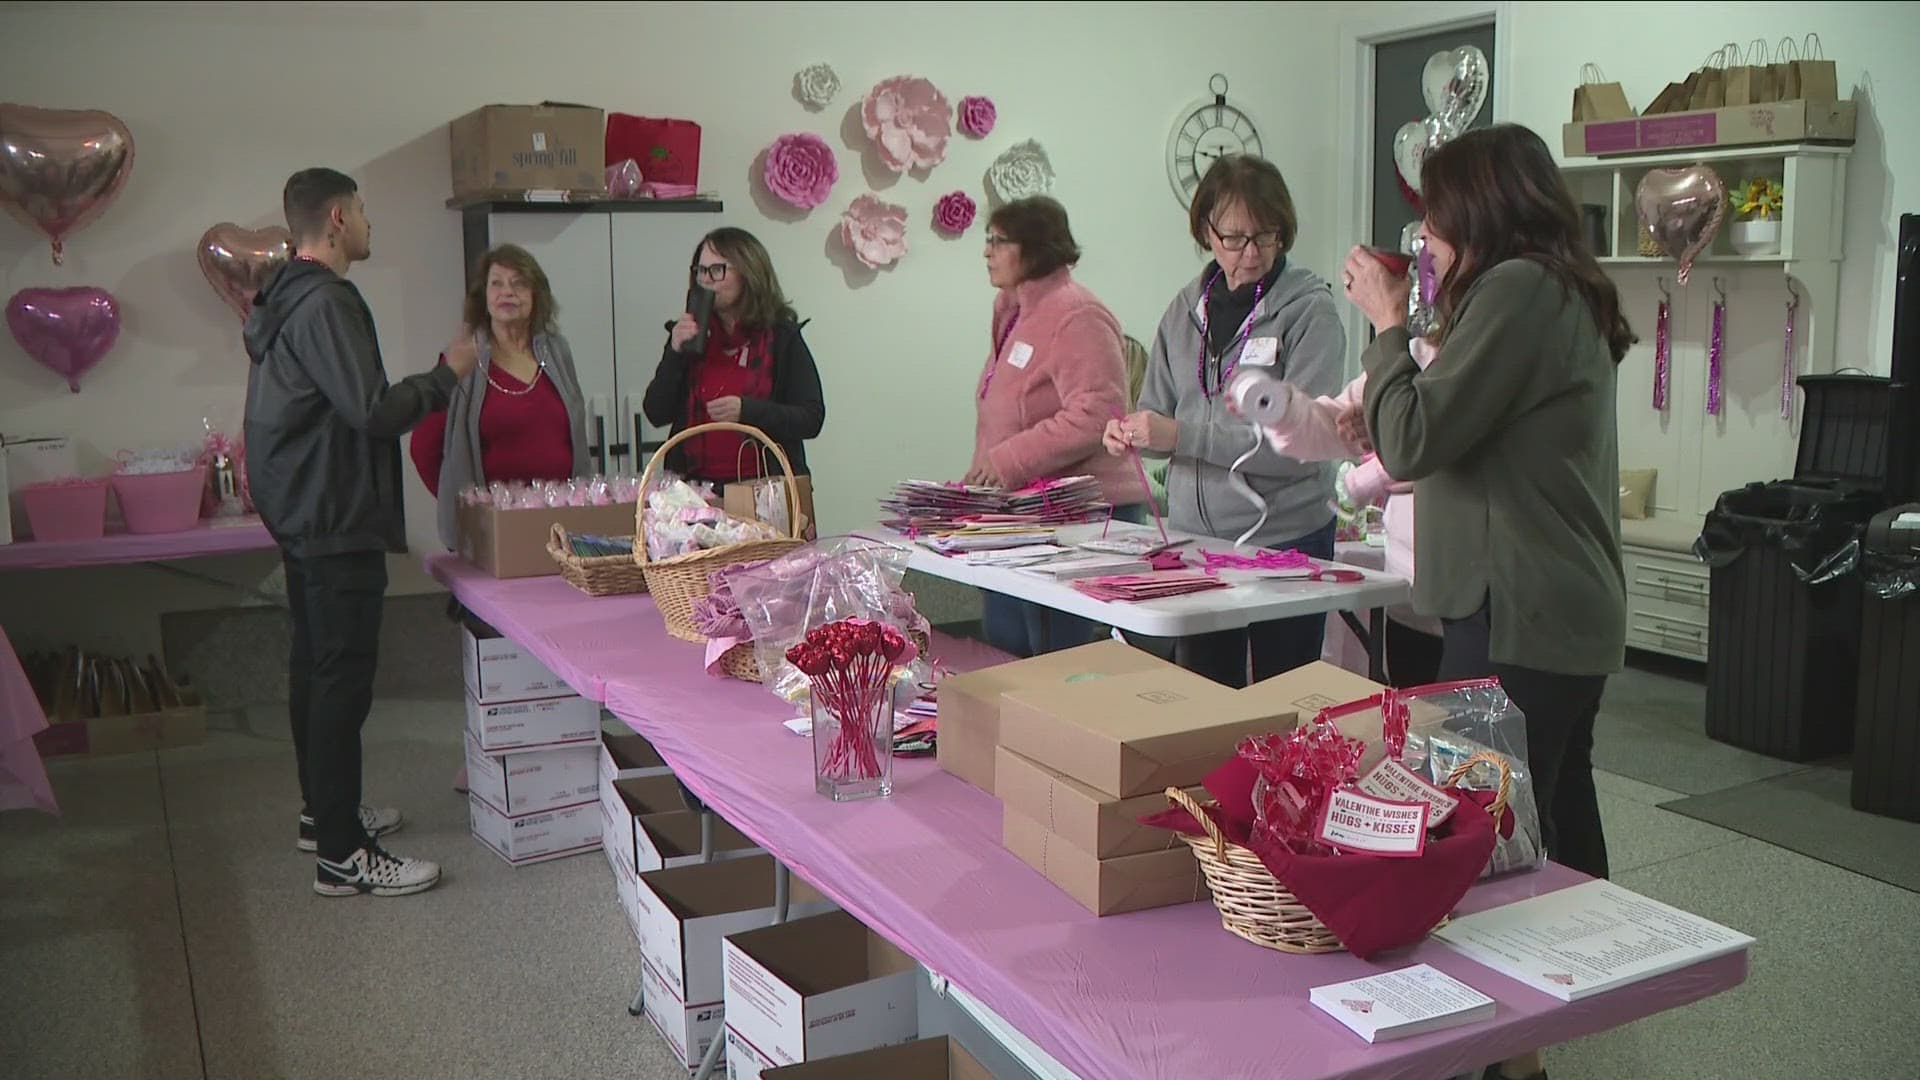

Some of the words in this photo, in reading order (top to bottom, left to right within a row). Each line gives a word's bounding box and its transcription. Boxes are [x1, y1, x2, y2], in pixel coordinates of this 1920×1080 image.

[1373, 771, 1400, 794] HUGS
[1383, 762, 1421, 793] VALENTINE
[1421, 790, 1453, 809] WISHES
[1335, 796, 1380, 817] VALENTINE
[1383, 809, 1418, 820] WISHES
[1331, 811, 1362, 828] HUGS
[1372, 821, 1416, 834] KISSES
